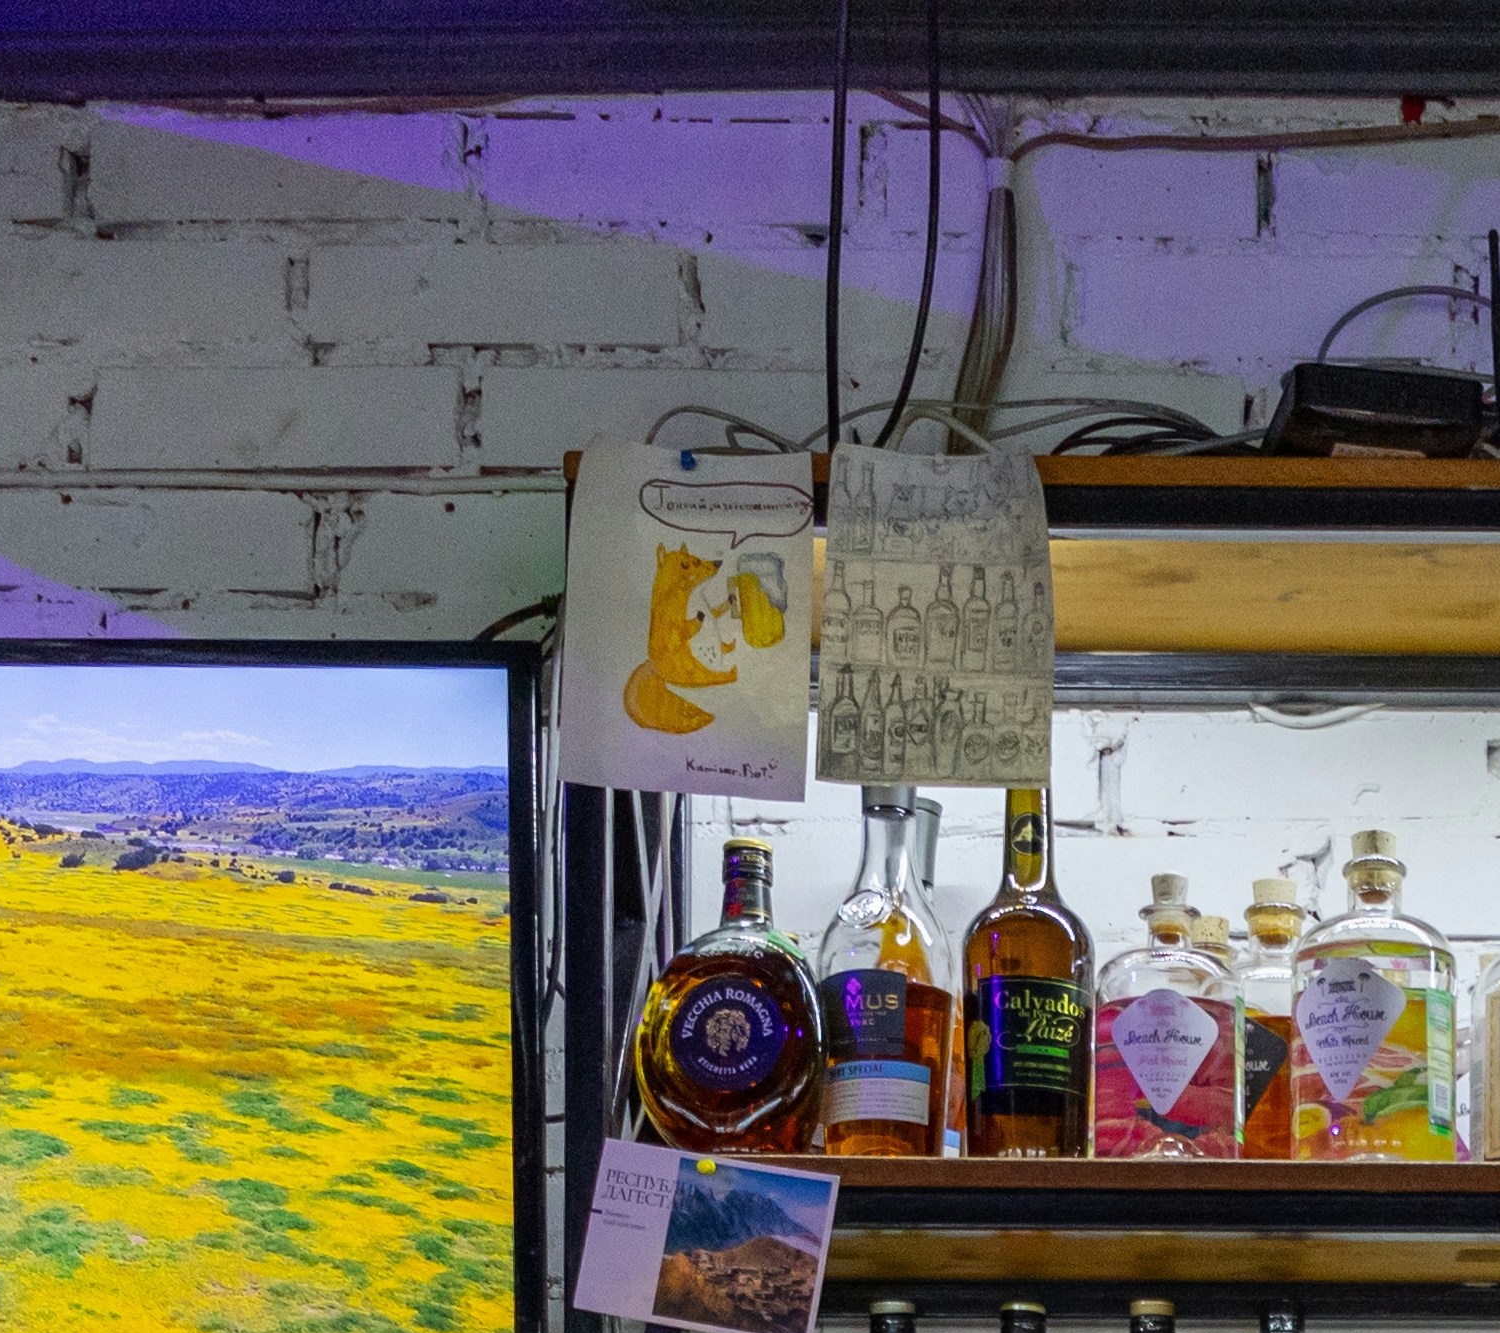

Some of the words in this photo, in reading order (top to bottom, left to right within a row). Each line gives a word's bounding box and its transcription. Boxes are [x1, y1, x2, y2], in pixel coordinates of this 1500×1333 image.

[682, 991, 723, 1039] VECCHIA
[726, 987, 774, 1038] ROMAGNA
[994, 992, 1086, 1019] Calvados
